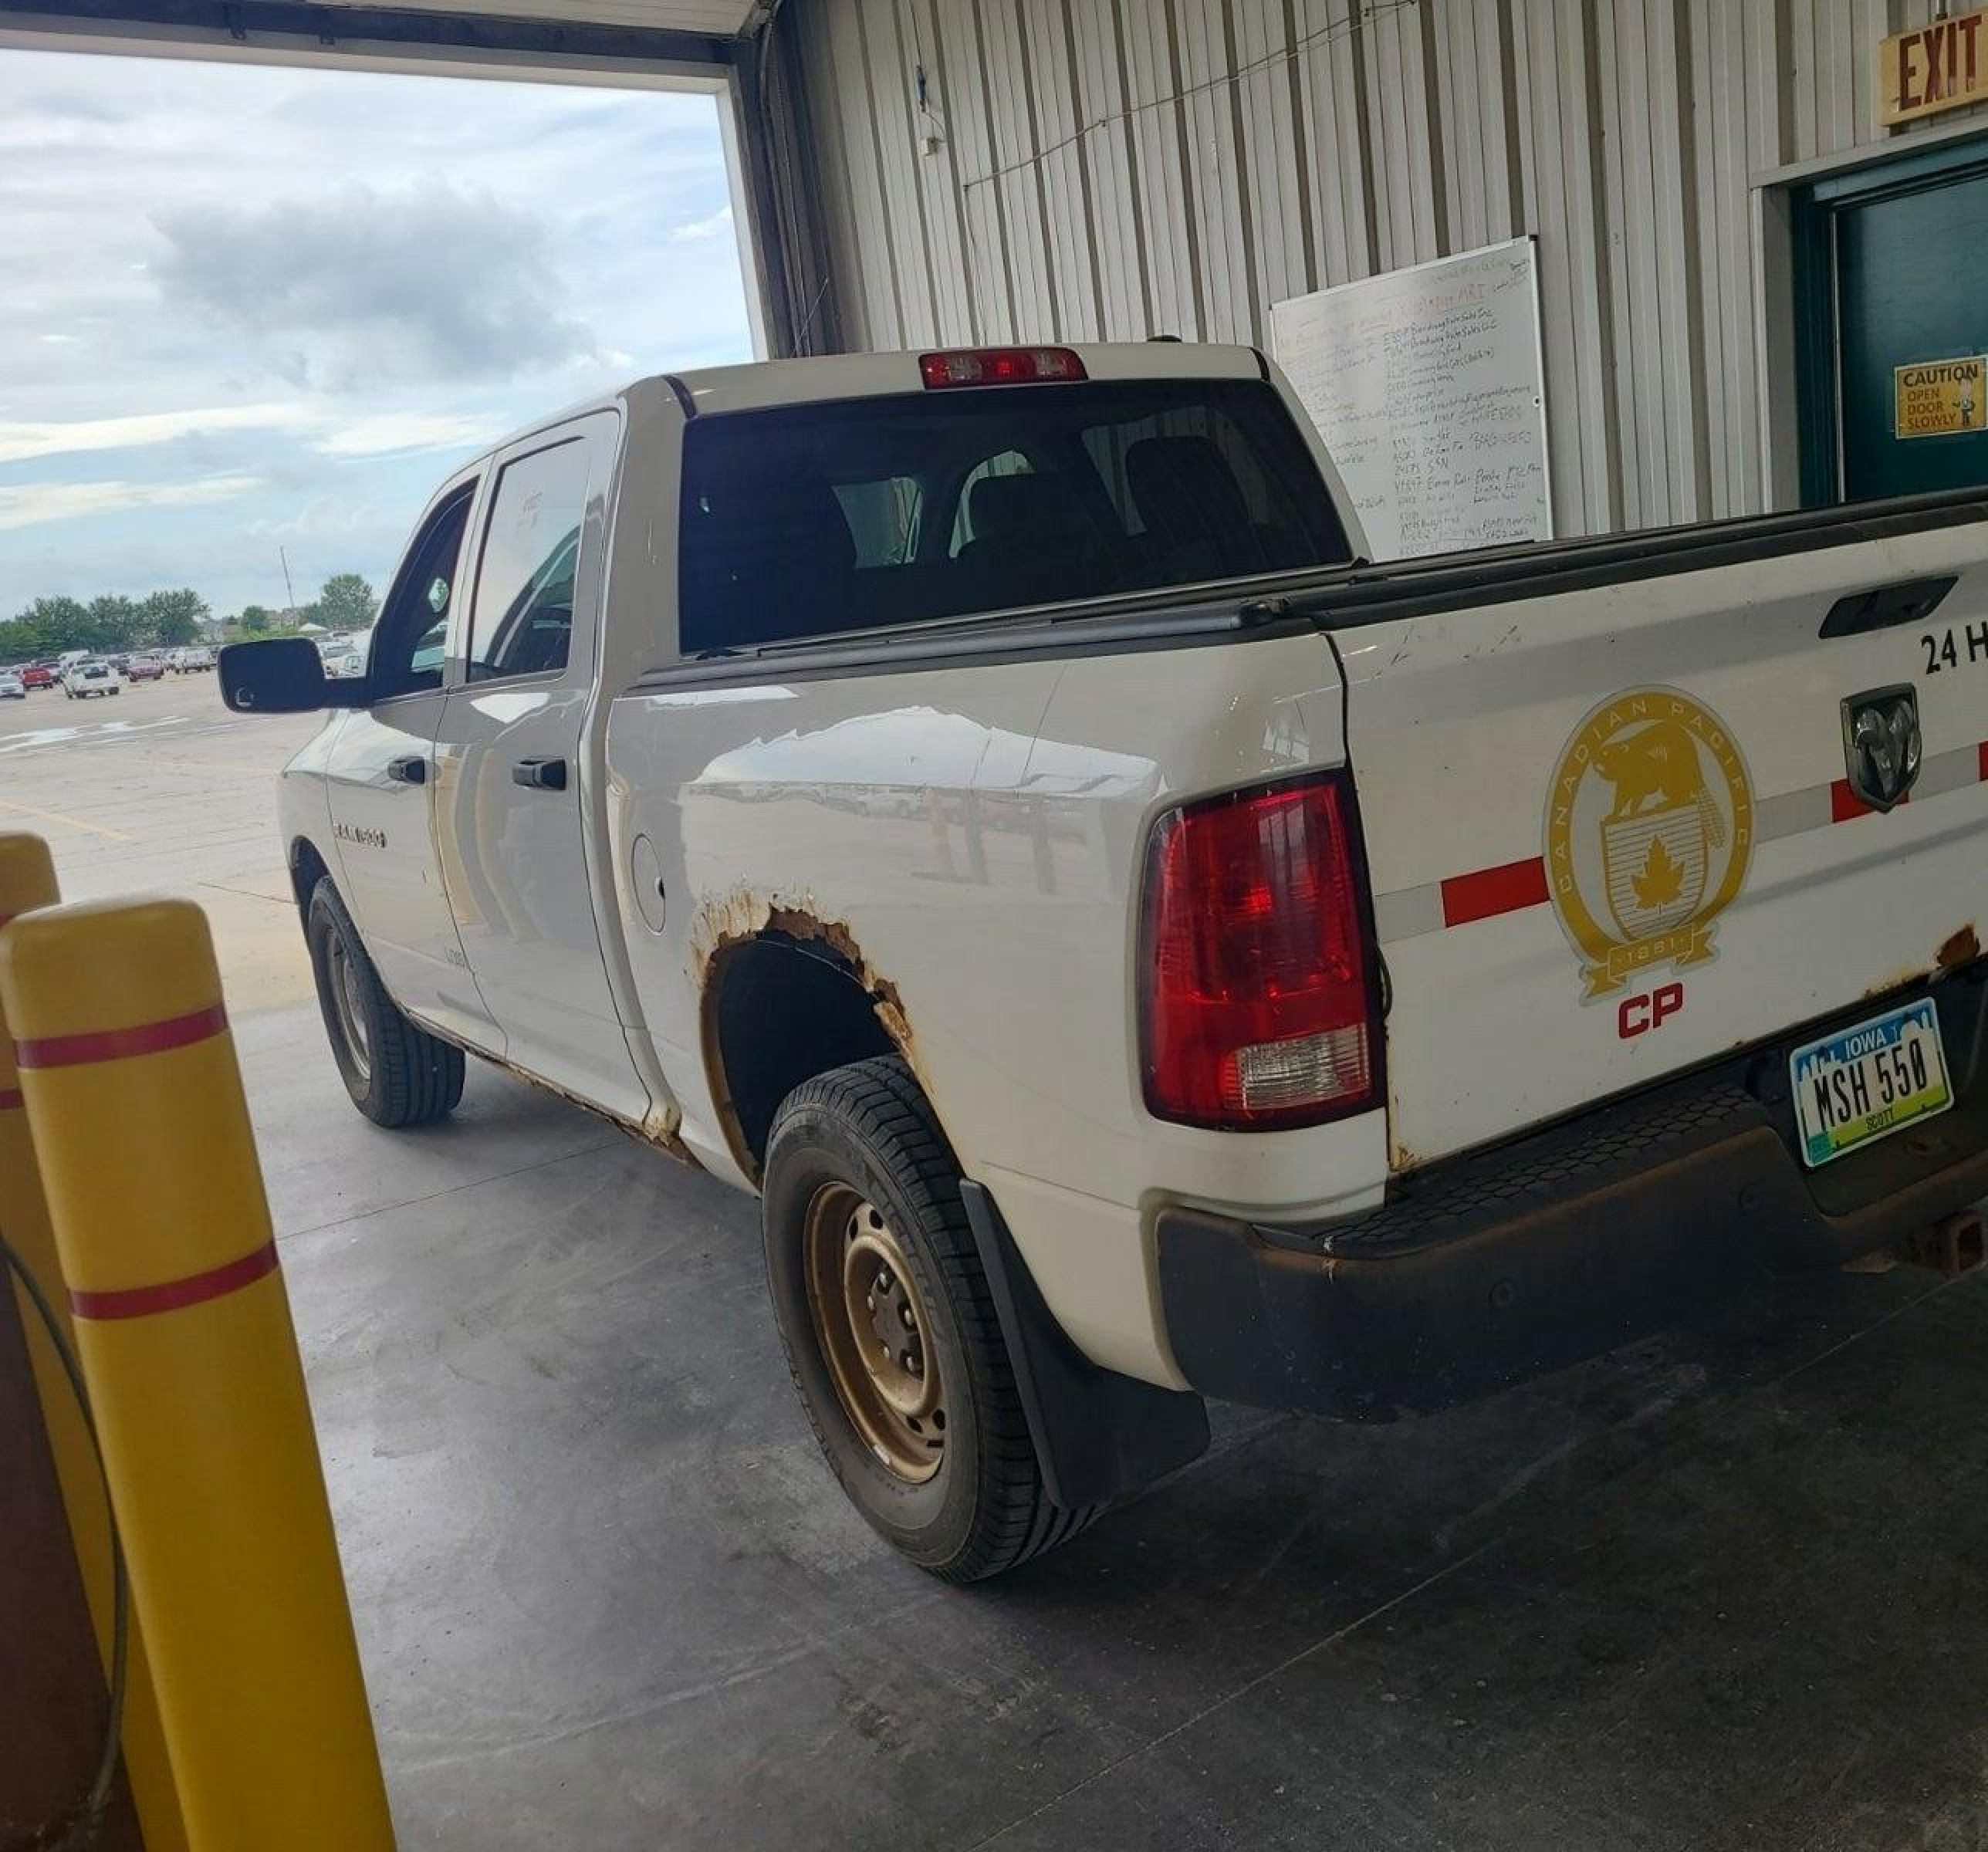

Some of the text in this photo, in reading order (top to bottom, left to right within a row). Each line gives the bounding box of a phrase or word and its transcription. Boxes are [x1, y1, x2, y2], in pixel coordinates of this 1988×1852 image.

[1899, 14, 1983, 111] EXIT
[1903, 364, 1978, 387] CAUTION
[1907, 387, 1940, 401] OPEN
[1907, 400, 1944, 415] DOOR
[1907, 413, 1956, 430] SLOWLY
[1921, 629, 1958, 674] 24
[1555, 700, 1748, 894] CANADIAN PACIFIC
[1618, 982, 1683, 1039] CP
[1845, 1026, 1887, 1059] IOWA
[1814, 1038, 1928, 1130] MSH 550
[1866, 1107, 1893, 1130] SCOTT
